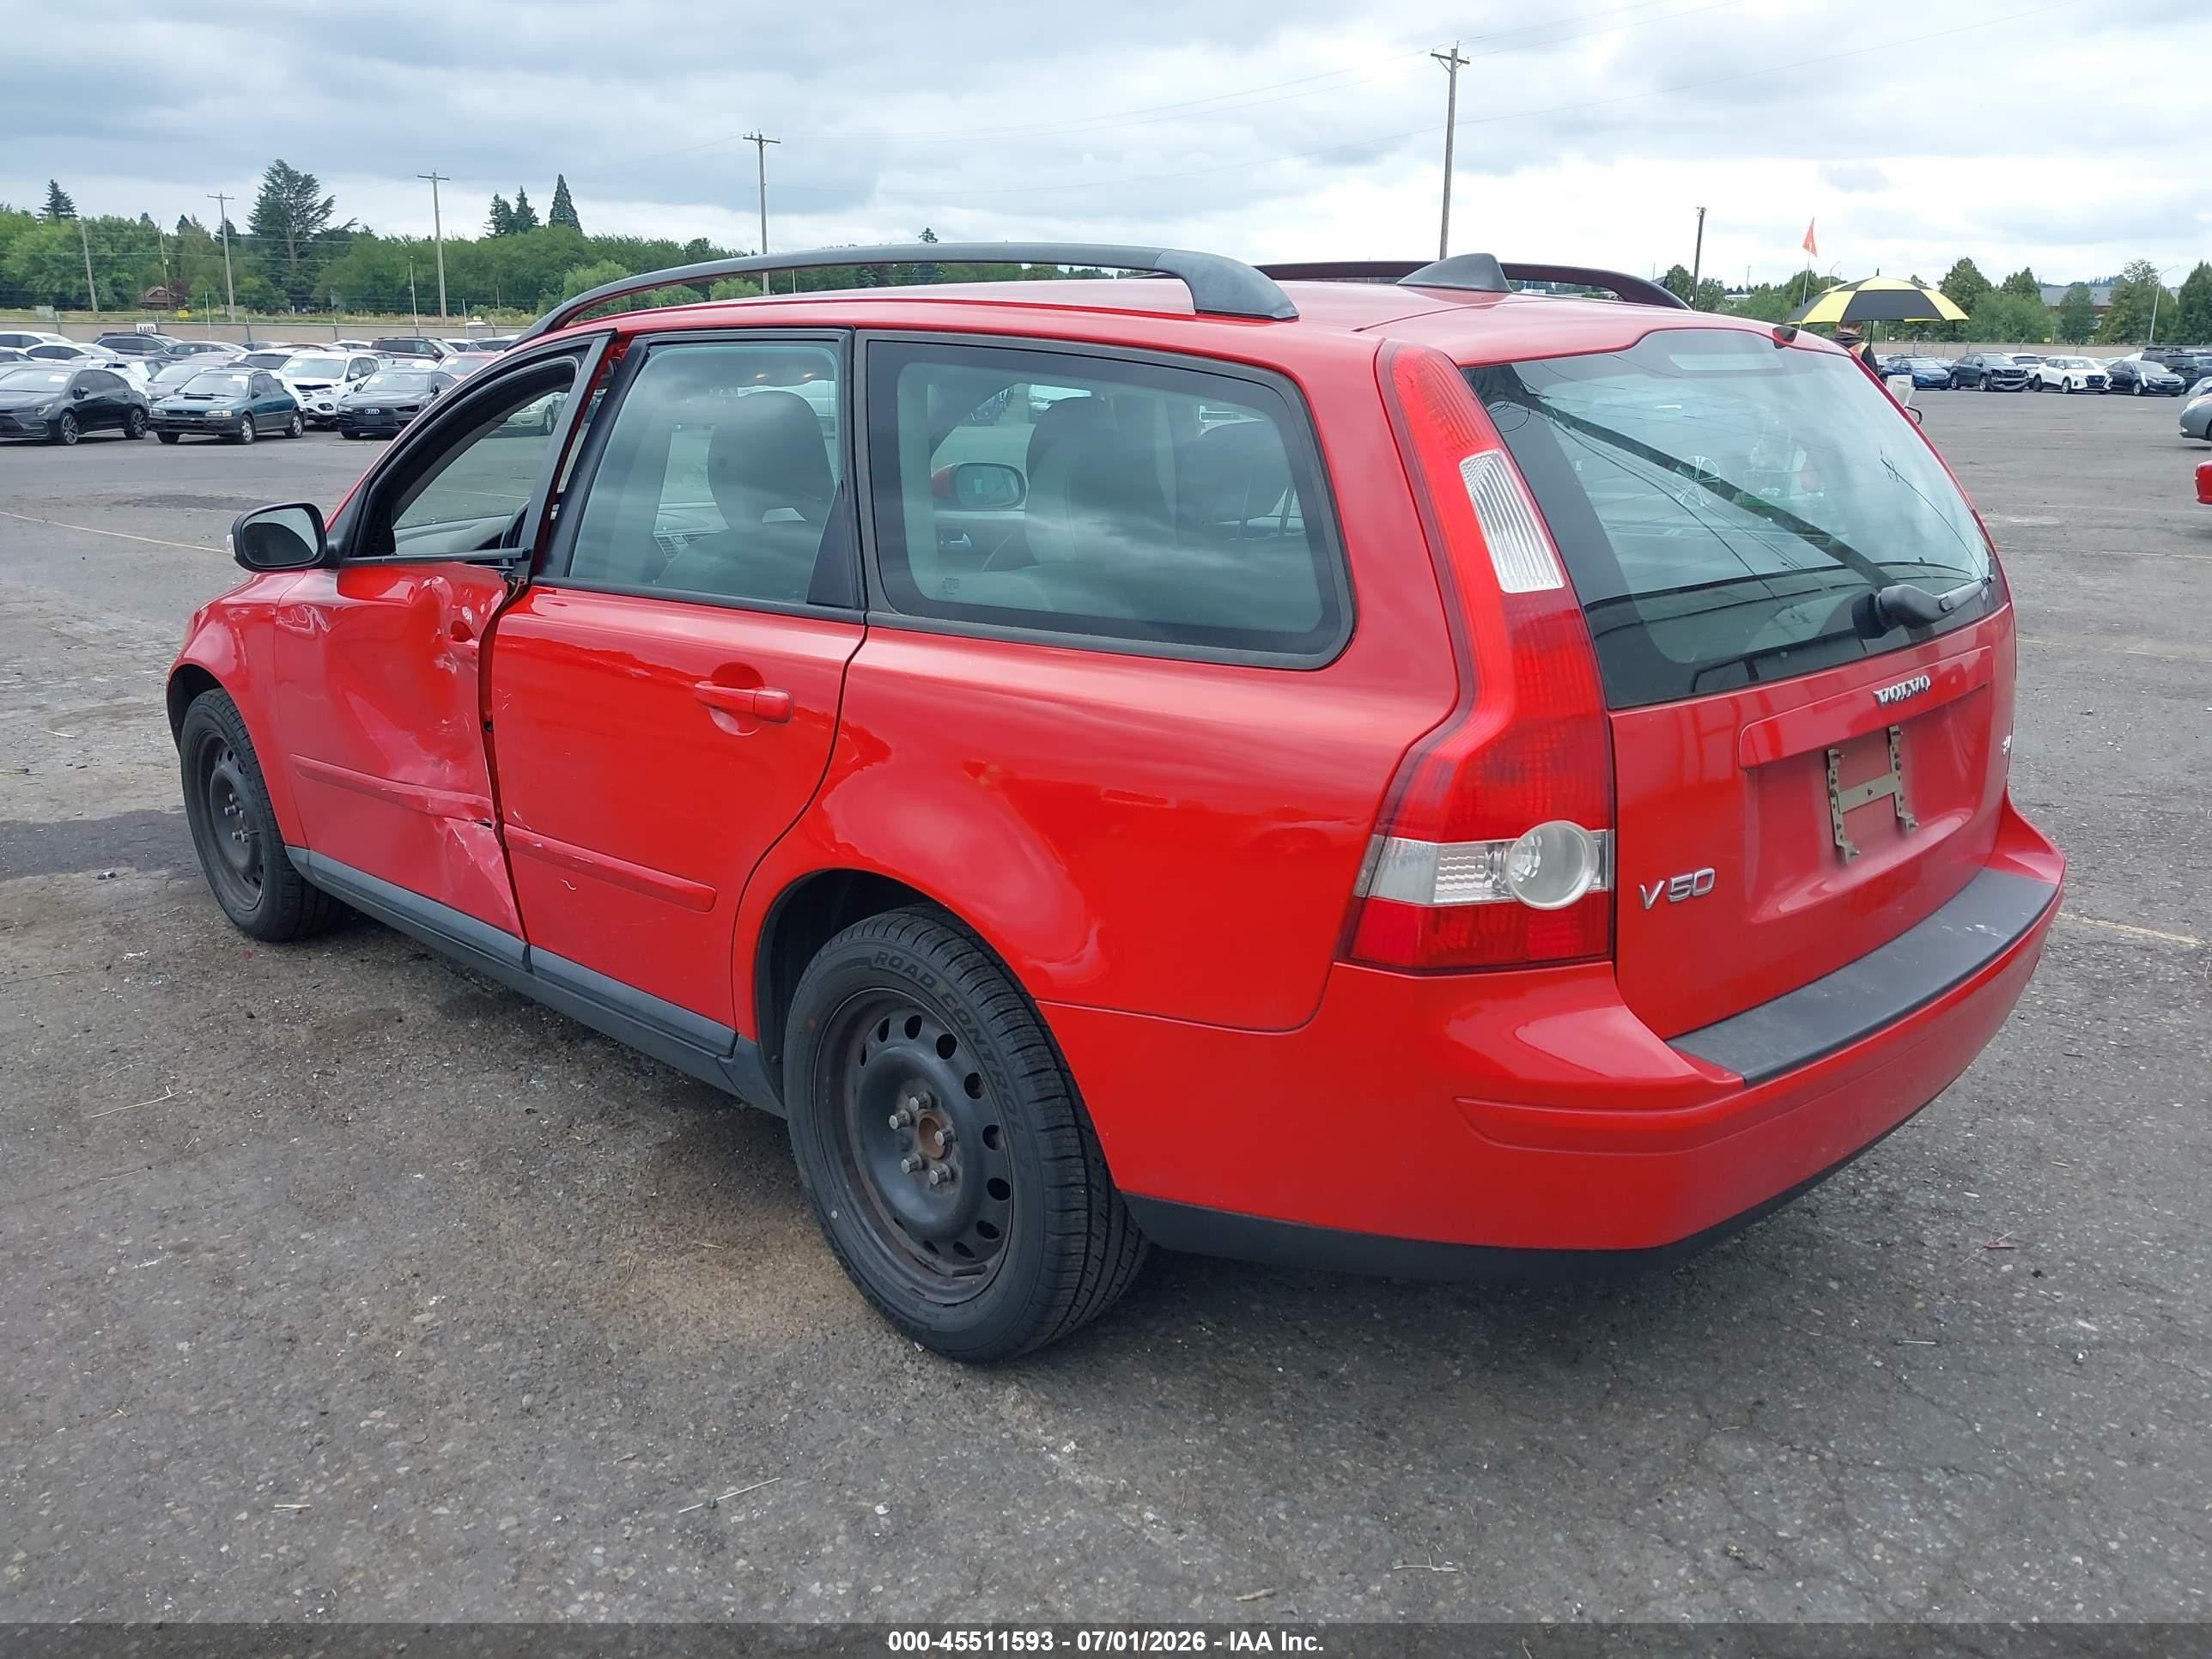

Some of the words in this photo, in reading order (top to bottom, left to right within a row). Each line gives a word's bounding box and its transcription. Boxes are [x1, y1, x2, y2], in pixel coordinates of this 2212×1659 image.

[1873, 675, 1931, 705] VOLVO
[1638, 867, 1716, 910] V50
[873, 951, 938, 989] ROAD
[940, 992, 1024, 1134] CONTROL
